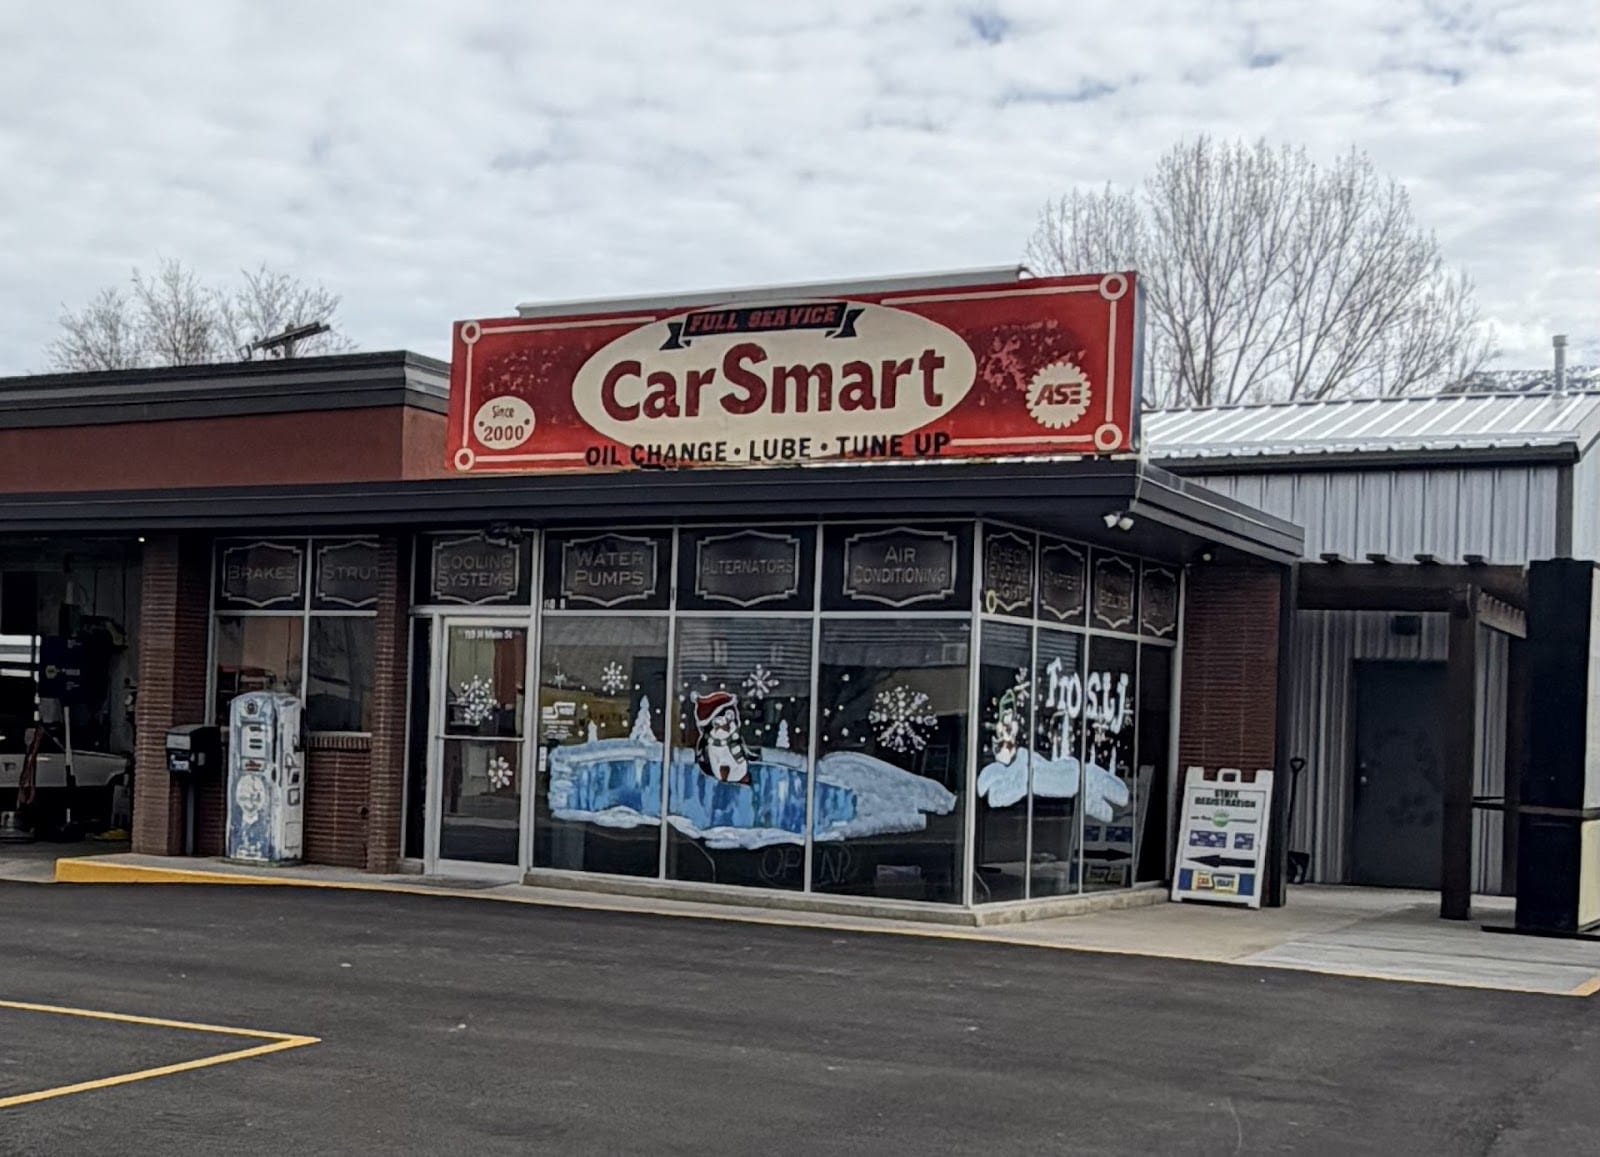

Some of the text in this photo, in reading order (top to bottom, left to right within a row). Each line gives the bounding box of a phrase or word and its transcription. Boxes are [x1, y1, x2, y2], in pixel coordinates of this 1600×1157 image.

[689, 305, 839, 333] FULL SERVICE
[601, 342, 945, 422] CarSmart
[1034, 382, 1082, 406] ASE
[492, 404, 515, 419] Since
[483, 424, 525, 442] 2000
[585, 431, 950, 466] OIL CHANGE LUBE TUNE UP
[438, 553, 514, 570] COOLING
[574, 550, 645, 567] WATER
[884, 545, 916, 563] AIR
[228, 564, 297, 580] BRAKES
[322, 563, 380, 580] STRUT
[702, 557, 795, 576] ALTERNATORS
[853, 564, 947, 584] CONDITIONING
[437, 570, 514, 587] SYSTEMS
[574, 569, 645, 586] PUMPS
[761, 847, 842, 884] OPN
